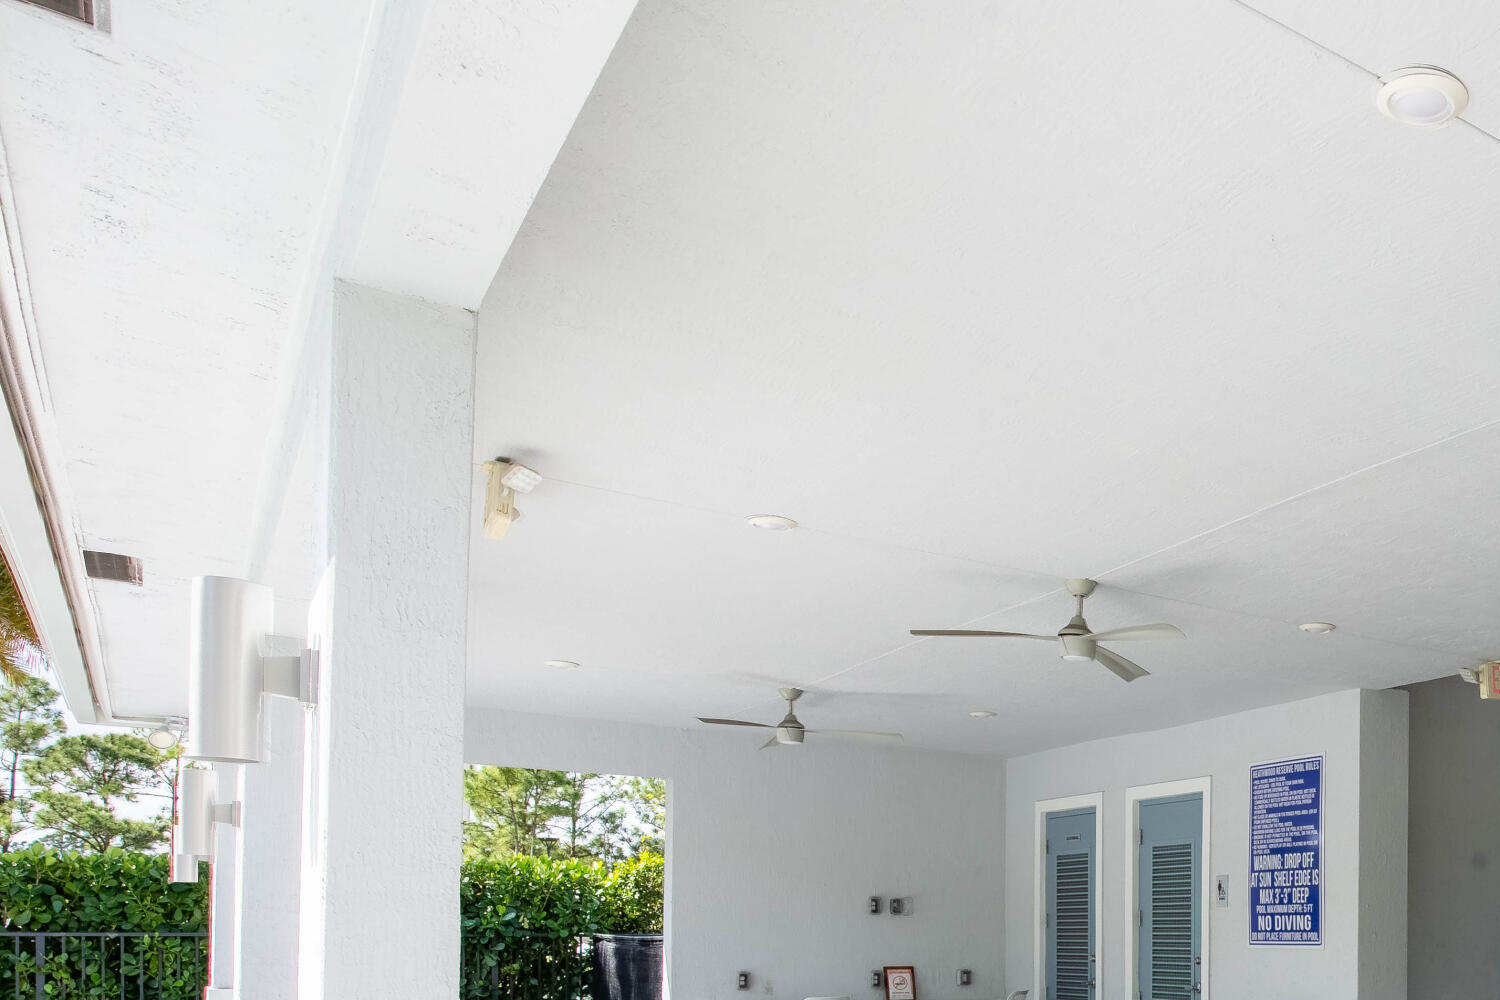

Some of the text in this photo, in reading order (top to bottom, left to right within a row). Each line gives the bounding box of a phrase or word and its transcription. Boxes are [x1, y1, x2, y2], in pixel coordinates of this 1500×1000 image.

[1254, 852, 1314, 871] WARNING: DROP OFF
[1250, 869, 1319, 888] AT SUN SHELF EDGE IS
[1260, 889, 1273, 904] MAX
[1292, 887, 1309, 903] DEEP
[1256, 905, 1266, 913] POOL
[1267, 905, 1288, 913] MAXIMUM
[1304, 904, 1307, 912] 5
[1308, 904, 1313, 912] FT
[1258, 915, 1312, 930] NO DIVING
